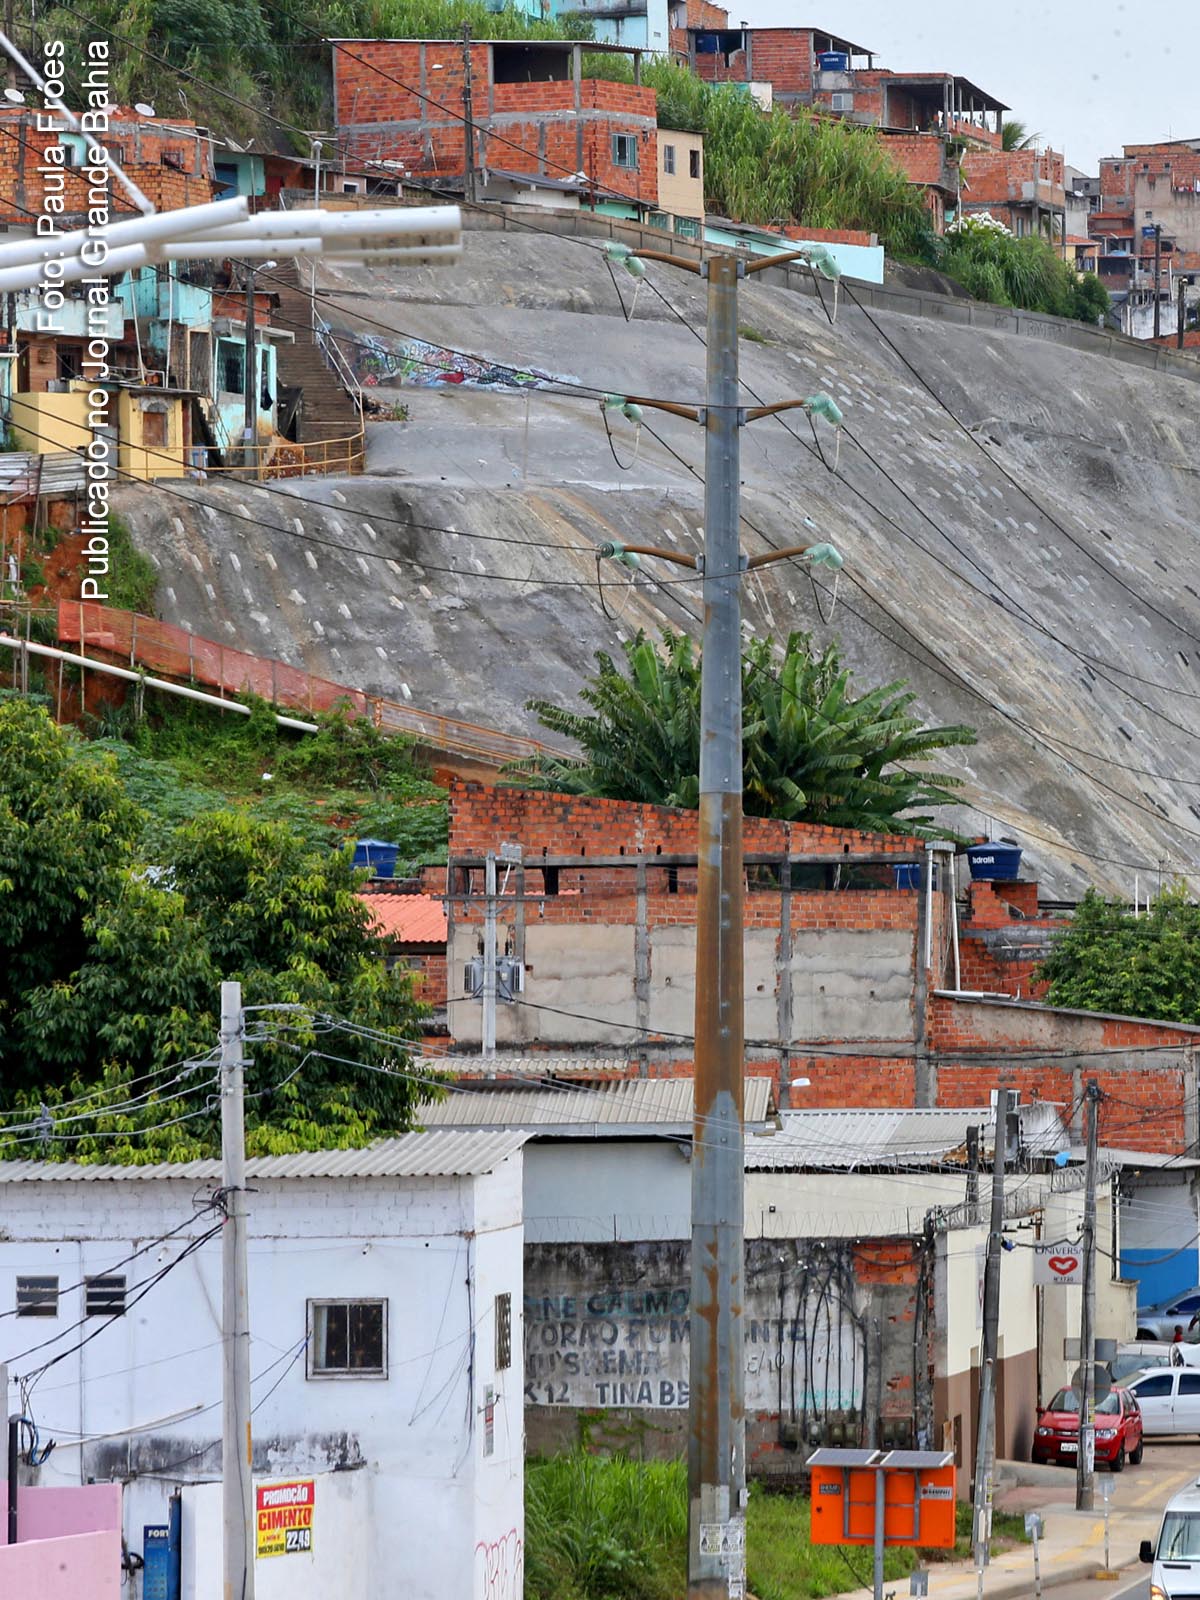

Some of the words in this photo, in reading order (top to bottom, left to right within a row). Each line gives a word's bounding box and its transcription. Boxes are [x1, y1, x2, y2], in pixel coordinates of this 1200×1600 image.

[1035, 1244, 1085, 1255] UNIVERSA
[596, 1381, 653, 1405] TINA
[263, 1484, 309, 1506] PROMOÇÃO
[258, 1508, 312, 1531] CIMENTO
